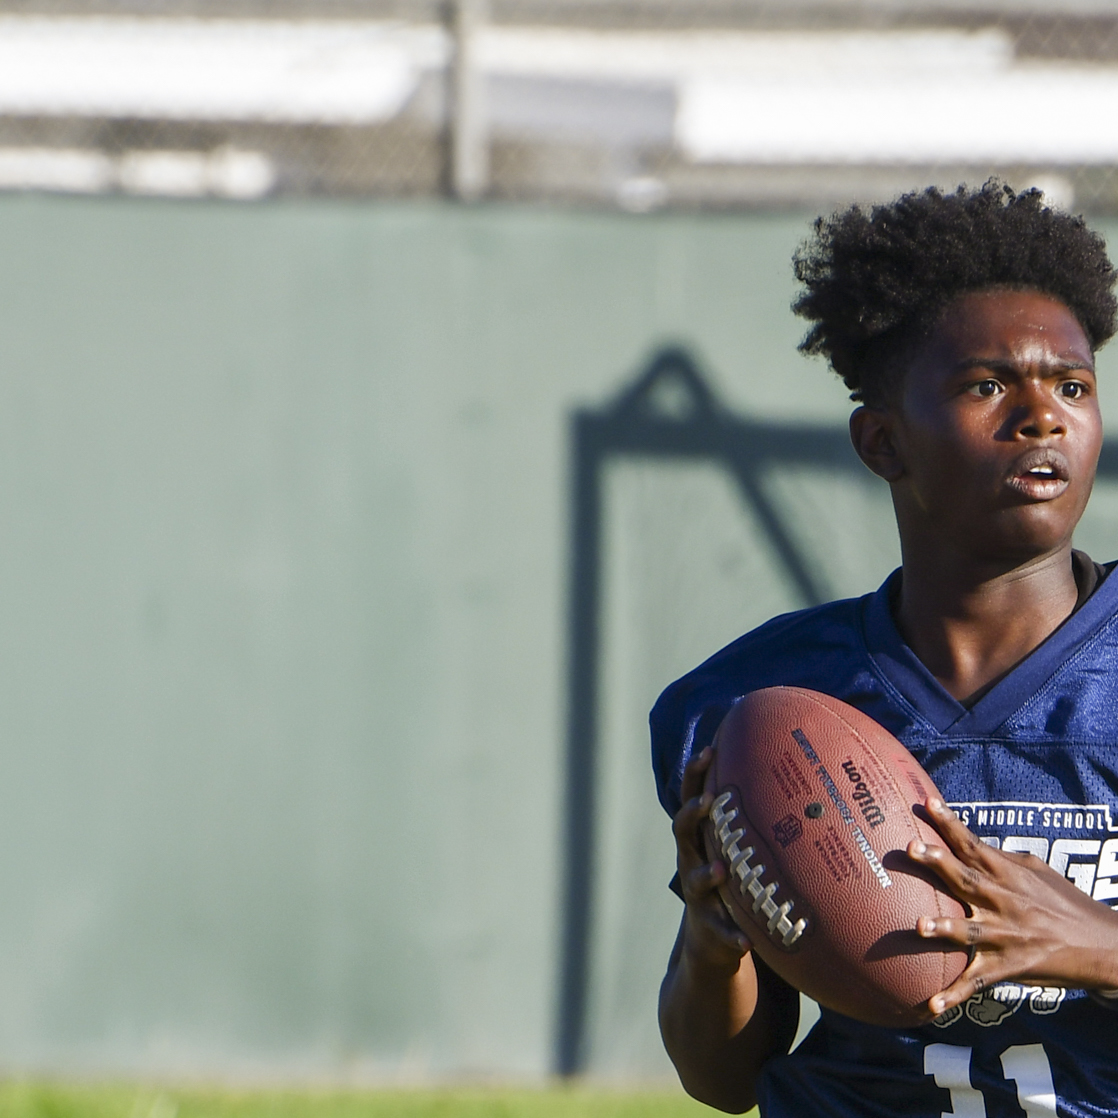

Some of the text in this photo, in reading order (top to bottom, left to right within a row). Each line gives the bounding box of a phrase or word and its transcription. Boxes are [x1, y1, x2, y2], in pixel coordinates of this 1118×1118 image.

[791, 727, 820, 766] LEAGUE
[816, 766, 855, 825] FOOTBALL
[841, 761, 886, 828] Wilson
[977, 809, 1034, 827] MIDDLE
[1042, 811, 1104, 830] SCHOOL
[852, 827, 893, 888] NATIONAL
